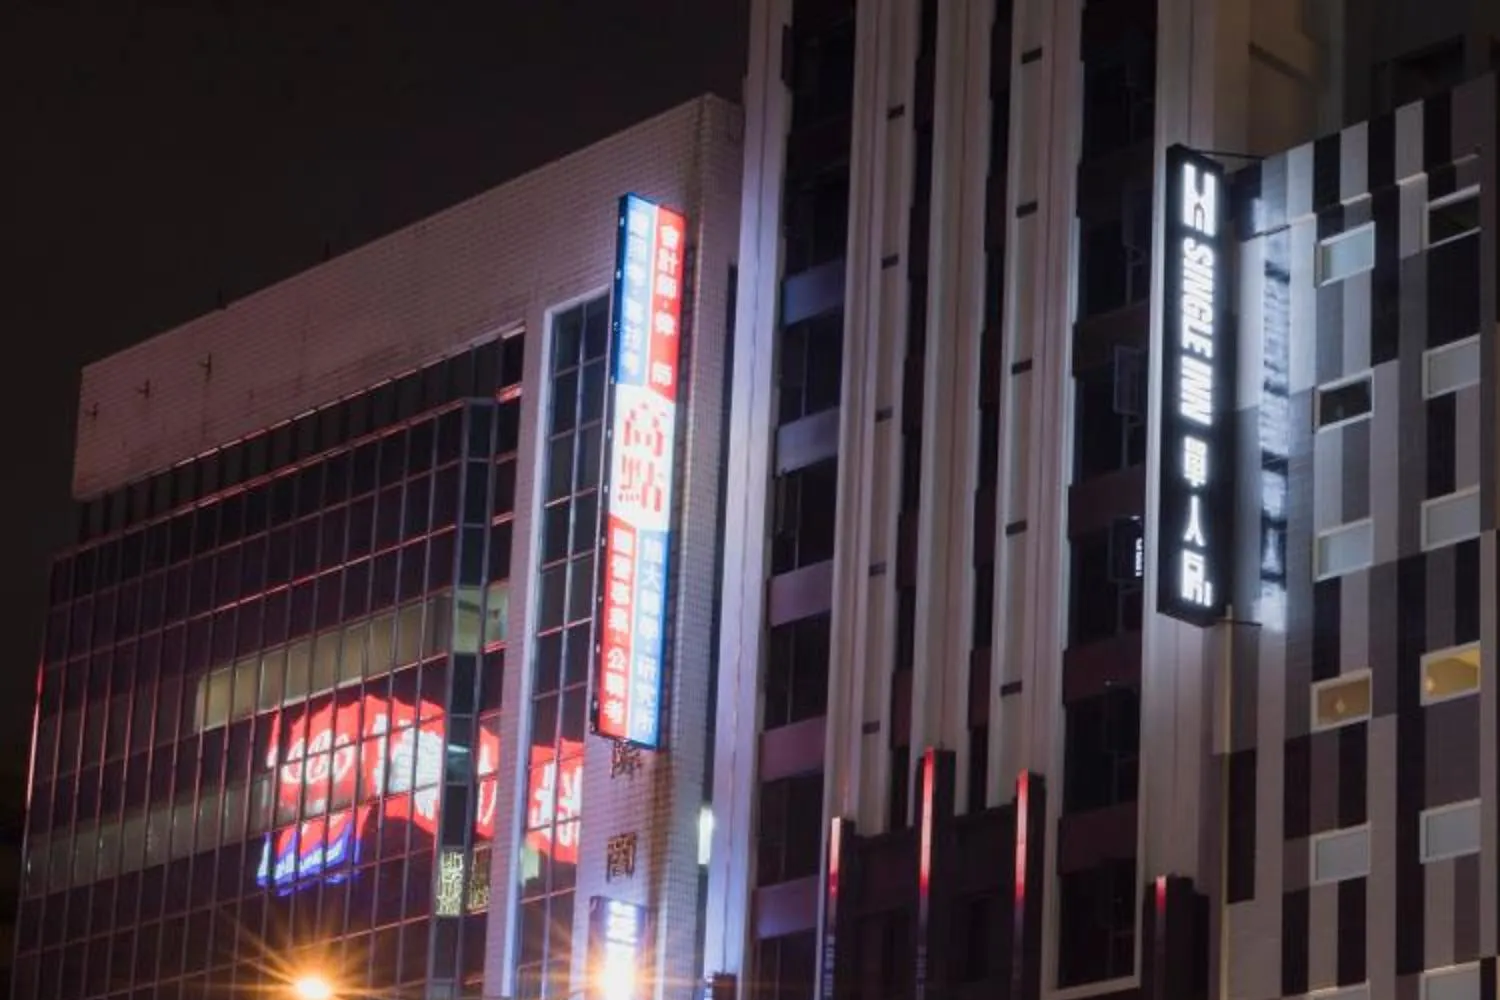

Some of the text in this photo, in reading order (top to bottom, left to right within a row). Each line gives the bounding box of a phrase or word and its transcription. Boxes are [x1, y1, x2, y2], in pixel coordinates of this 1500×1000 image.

[1180, 237, 1214, 358] SINGLE
[1180, 357, 1213, 425] INN
[1181, 434, 1213, 607] 單人房
